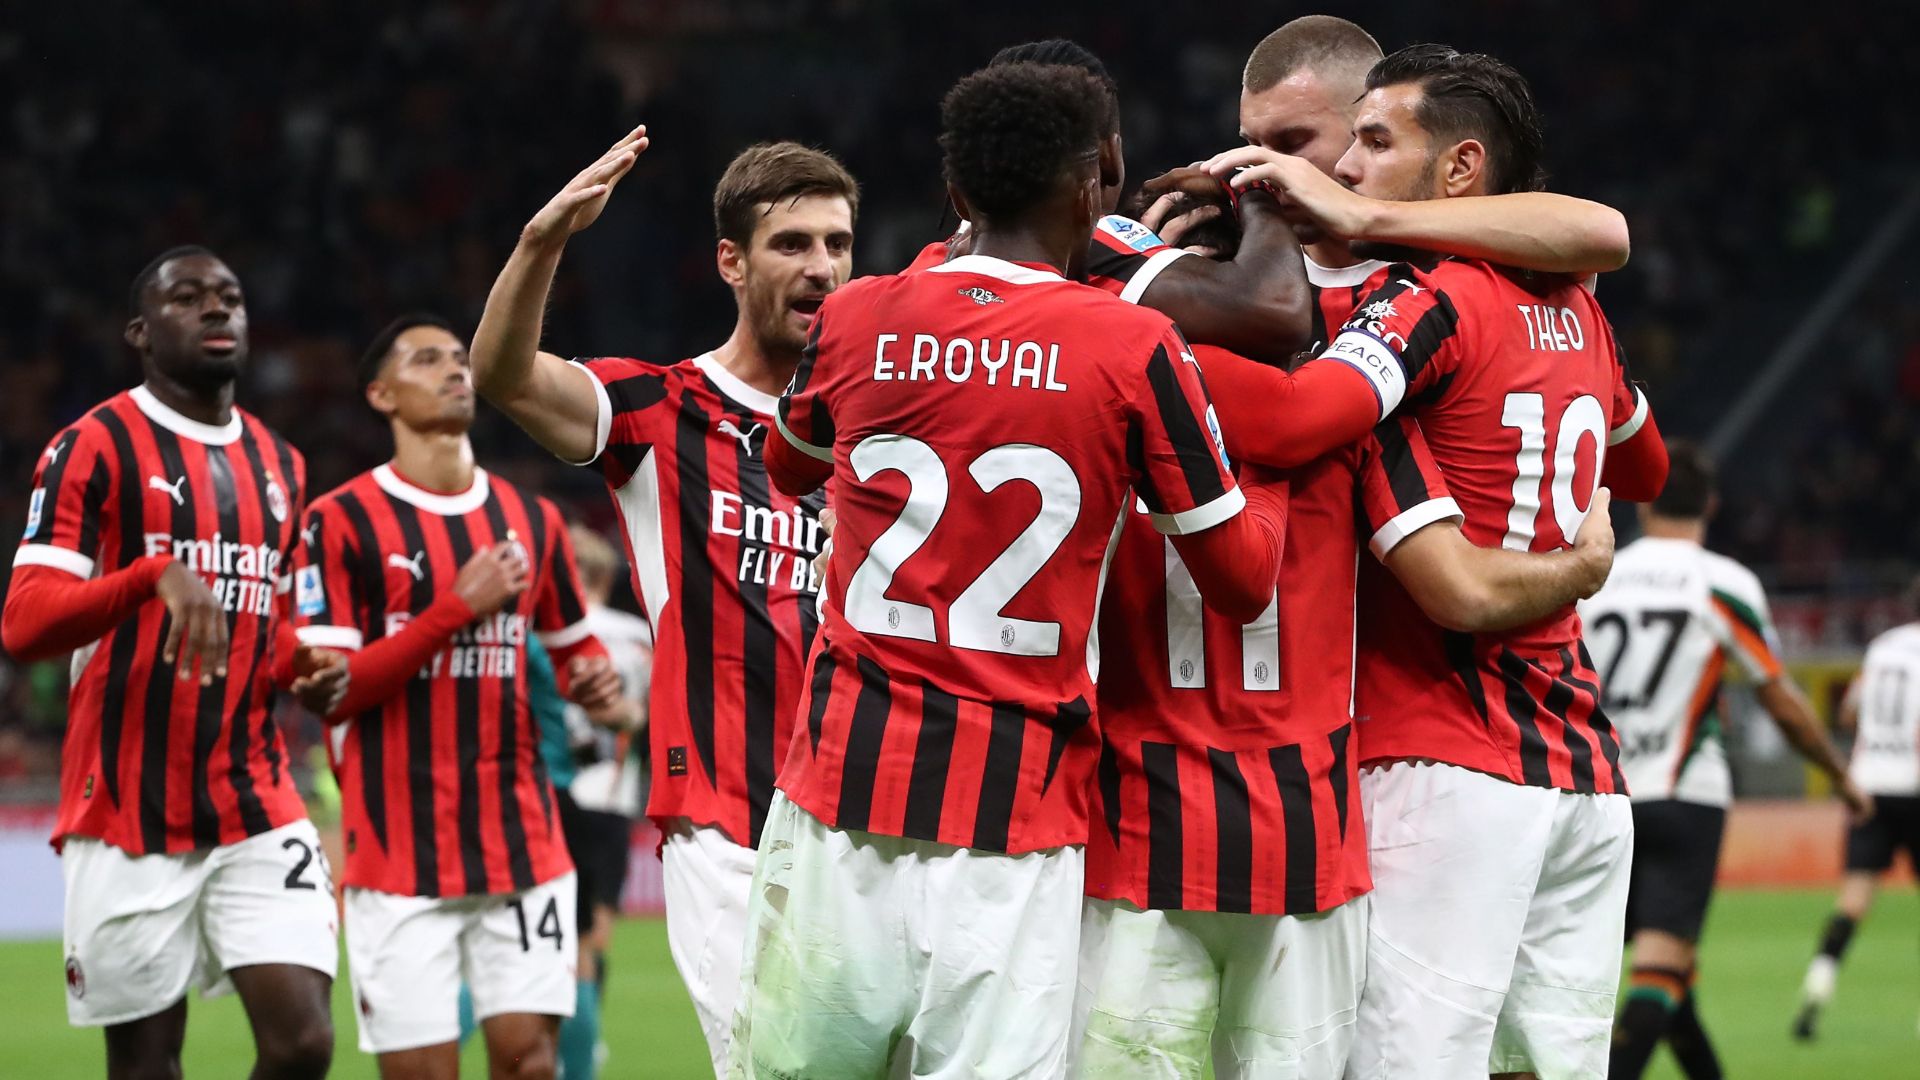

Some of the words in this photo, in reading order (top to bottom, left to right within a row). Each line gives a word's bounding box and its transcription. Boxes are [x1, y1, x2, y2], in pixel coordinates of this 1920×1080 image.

[1517, 303, 1585, 352] THEO
[873, 333, 1068, 392] E.ROYAL
[1333, 341, 1394, 384] EACE
[1500, 391, 1606, 552] 10
[711, 489, 824, 554] Emir
[844, 433, 1082, 657] 22
[143, 531, 283, 583] Emirate
[738, 546, 785, 587] FLY
[1592, 609, 1693, 712] 27
[505, 895, 563, 953] 14
